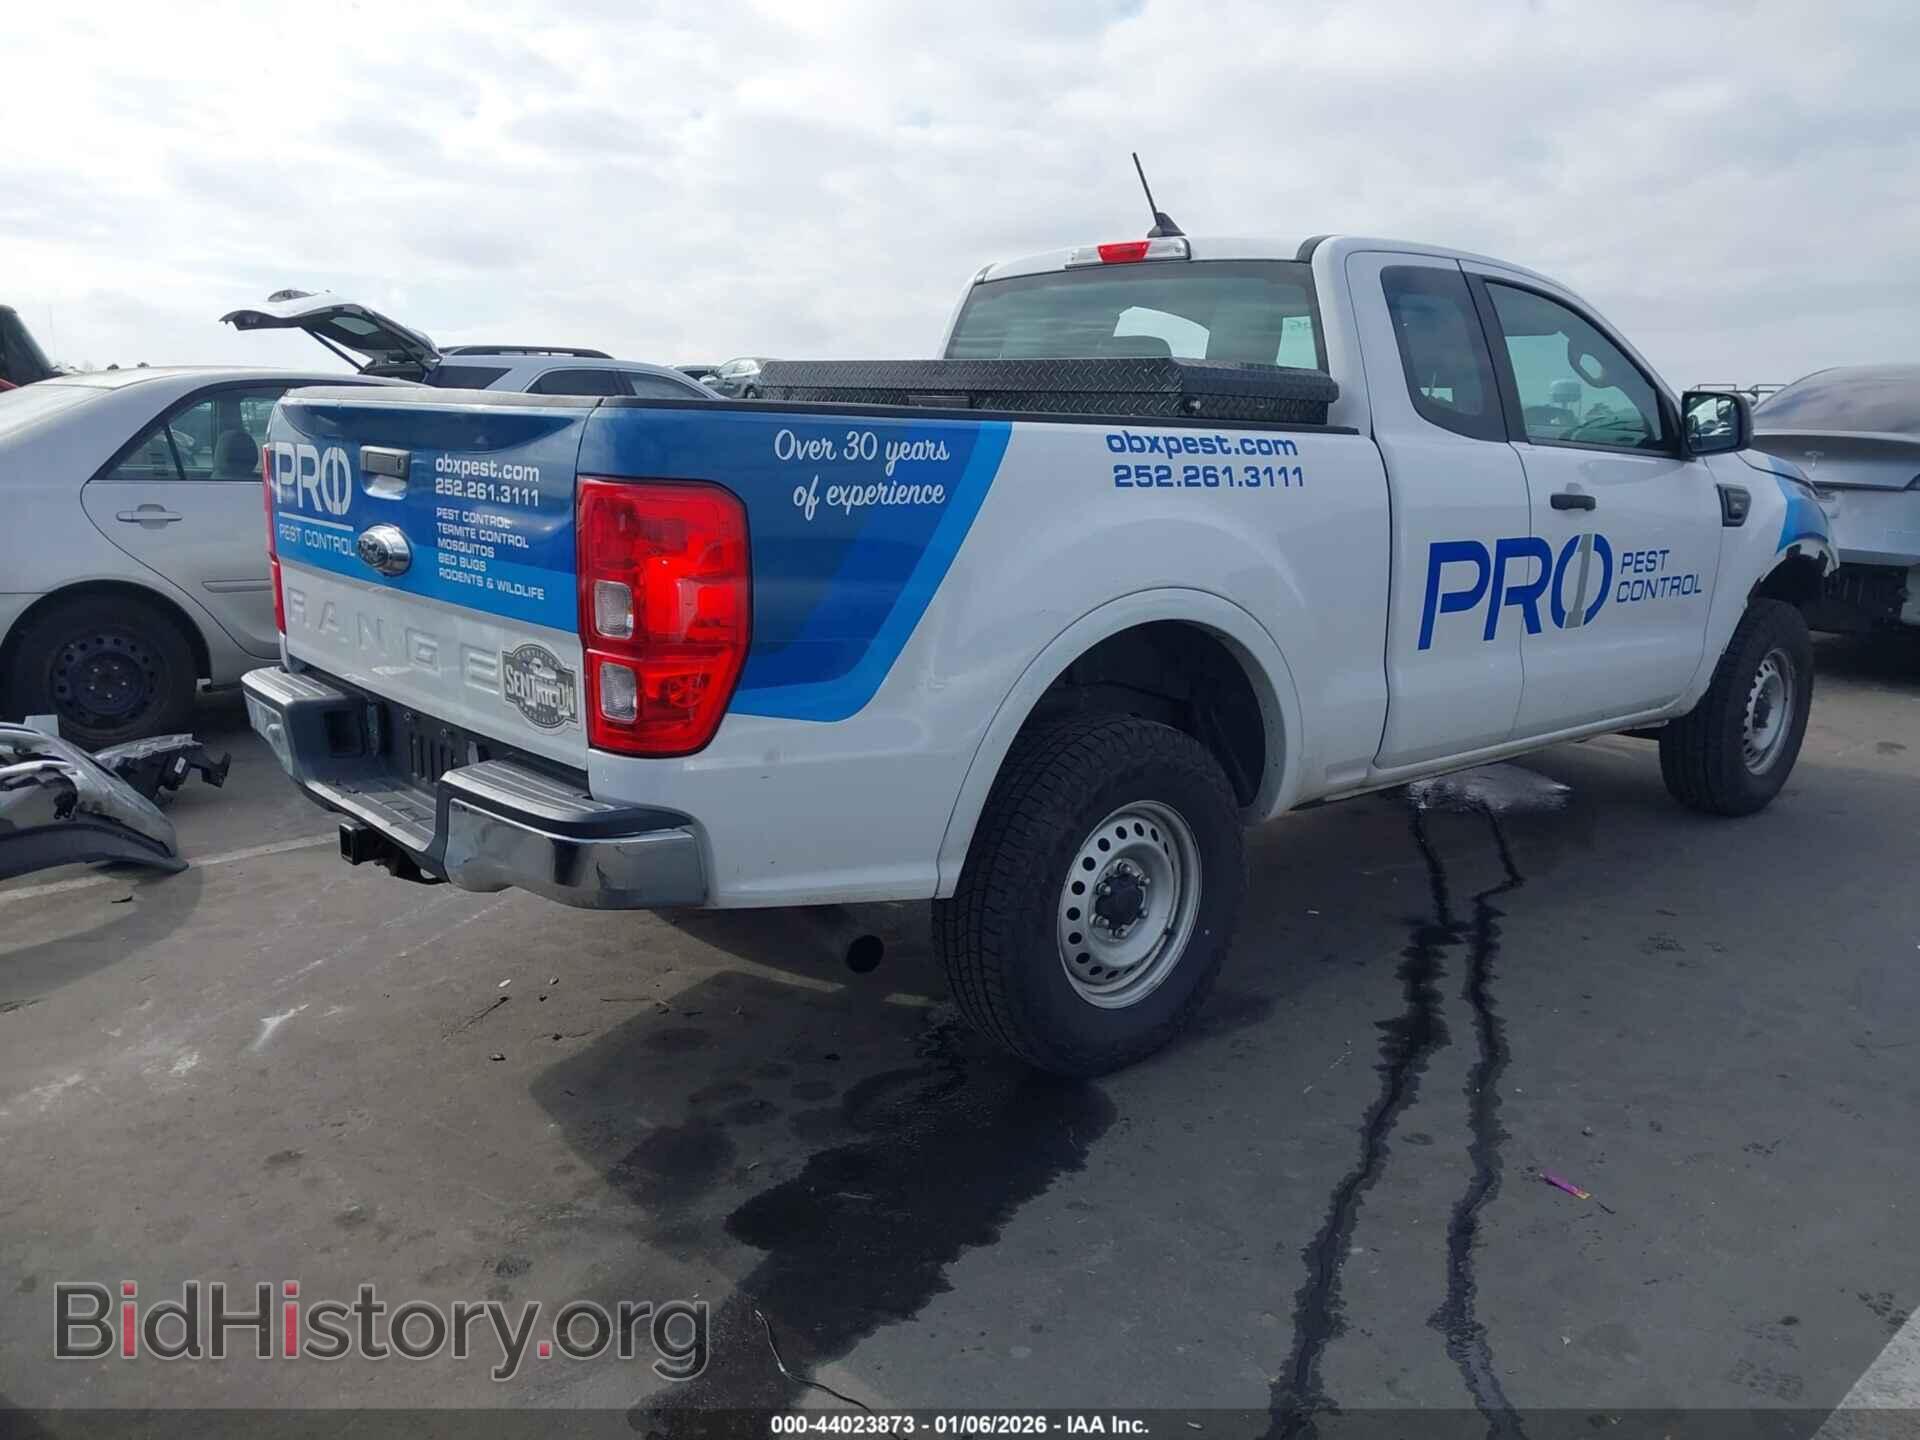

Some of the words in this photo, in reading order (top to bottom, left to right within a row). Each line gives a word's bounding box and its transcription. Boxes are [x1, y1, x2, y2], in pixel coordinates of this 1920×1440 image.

[774, 429, 837, 461] Over
[843, 430, 878, 461] 30
[885, 439, 950, 477] years
[1106, 429, 1298, 459] obxpest.com
[435, 453, 540, 482] obxpest.com
[1113, 464, 1304, 488] 252.261.3111
[435, 477, 539, 507] 252.261.3111
[792, 474, 820, 521] of
[826, 480, 946, 516] experience
[436, 507, 460, 521] PEST
[279, 523, 301, 543] PEST
[304, 529, 356, 556] CONTROL
[437, 522, 476, 539] TERMITE
[479, 529, 530, 548] CONTROL
[438, 537, 495, 559] MOSQUITOS
[438, 552, 457, 566] BED
[459, 556, 487, 572] BUGS
[1620, 549, 1670, 574] PEST
[439, 567, 484, 588] RODENTS
[486, 578, 494, 589] &
[496, 579, 545, 600] WILDLIFE
[1616, 574, 1702, 603] CONTROL
[287, 587, 500, 696] RANGE
